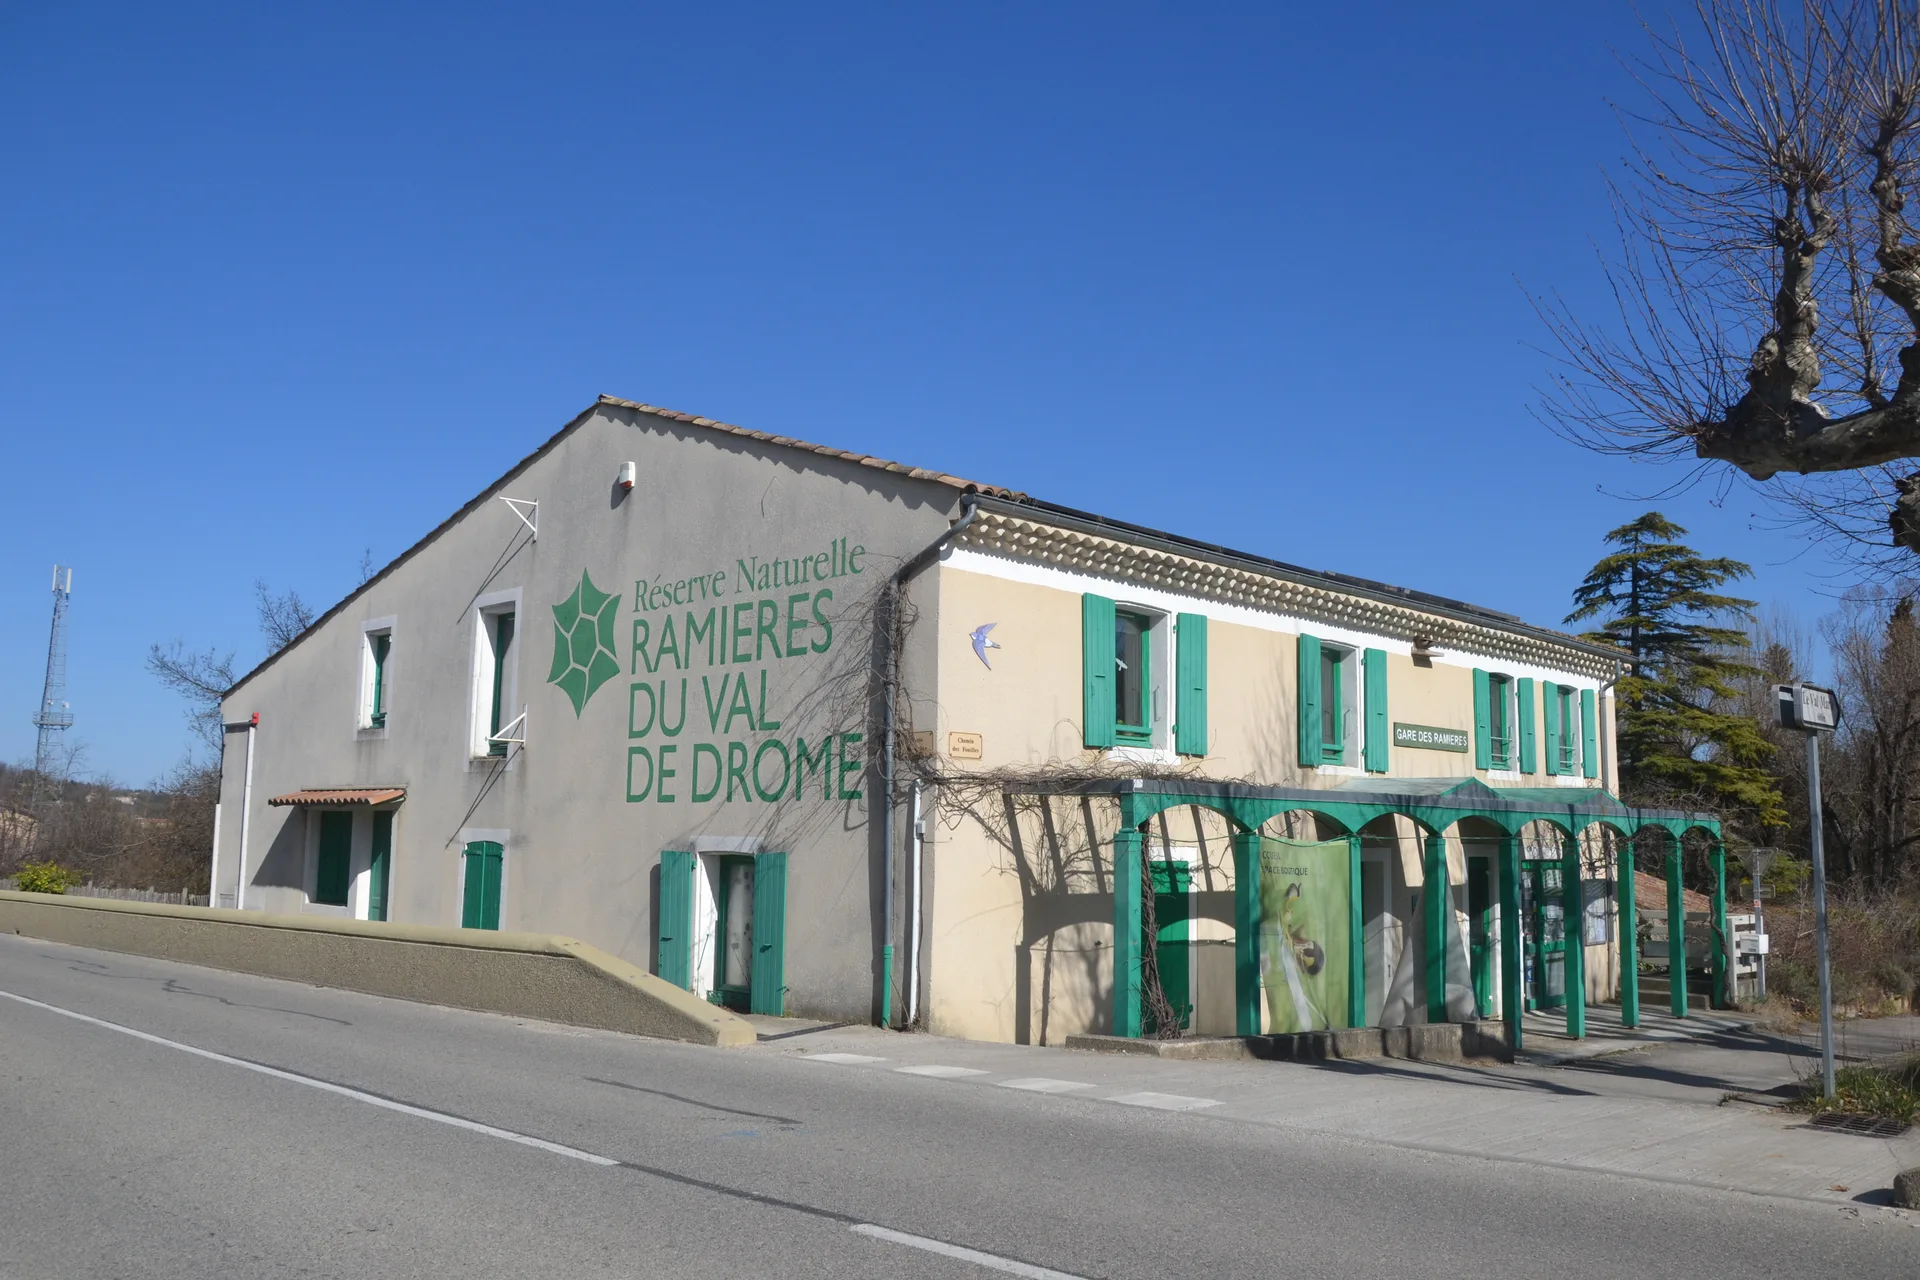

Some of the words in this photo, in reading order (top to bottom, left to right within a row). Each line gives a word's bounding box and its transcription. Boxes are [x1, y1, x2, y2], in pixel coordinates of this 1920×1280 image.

[633, 574, 726, 613] Réserve
[735, 537, 866, 594] Naturelle
[631, 588, 834, 675] RAMIERES
[628, 677, 687, 739] DU
[702, 669, 781, 734] VAL
[1396, 728, 1417, 741] GARE
[1418, 731, 1433, 743] DES
[1434, 732, 1467, 747] RAMIERES
[626, 745, 677, 803] DE
[691, 733, 863, 803] DROME
